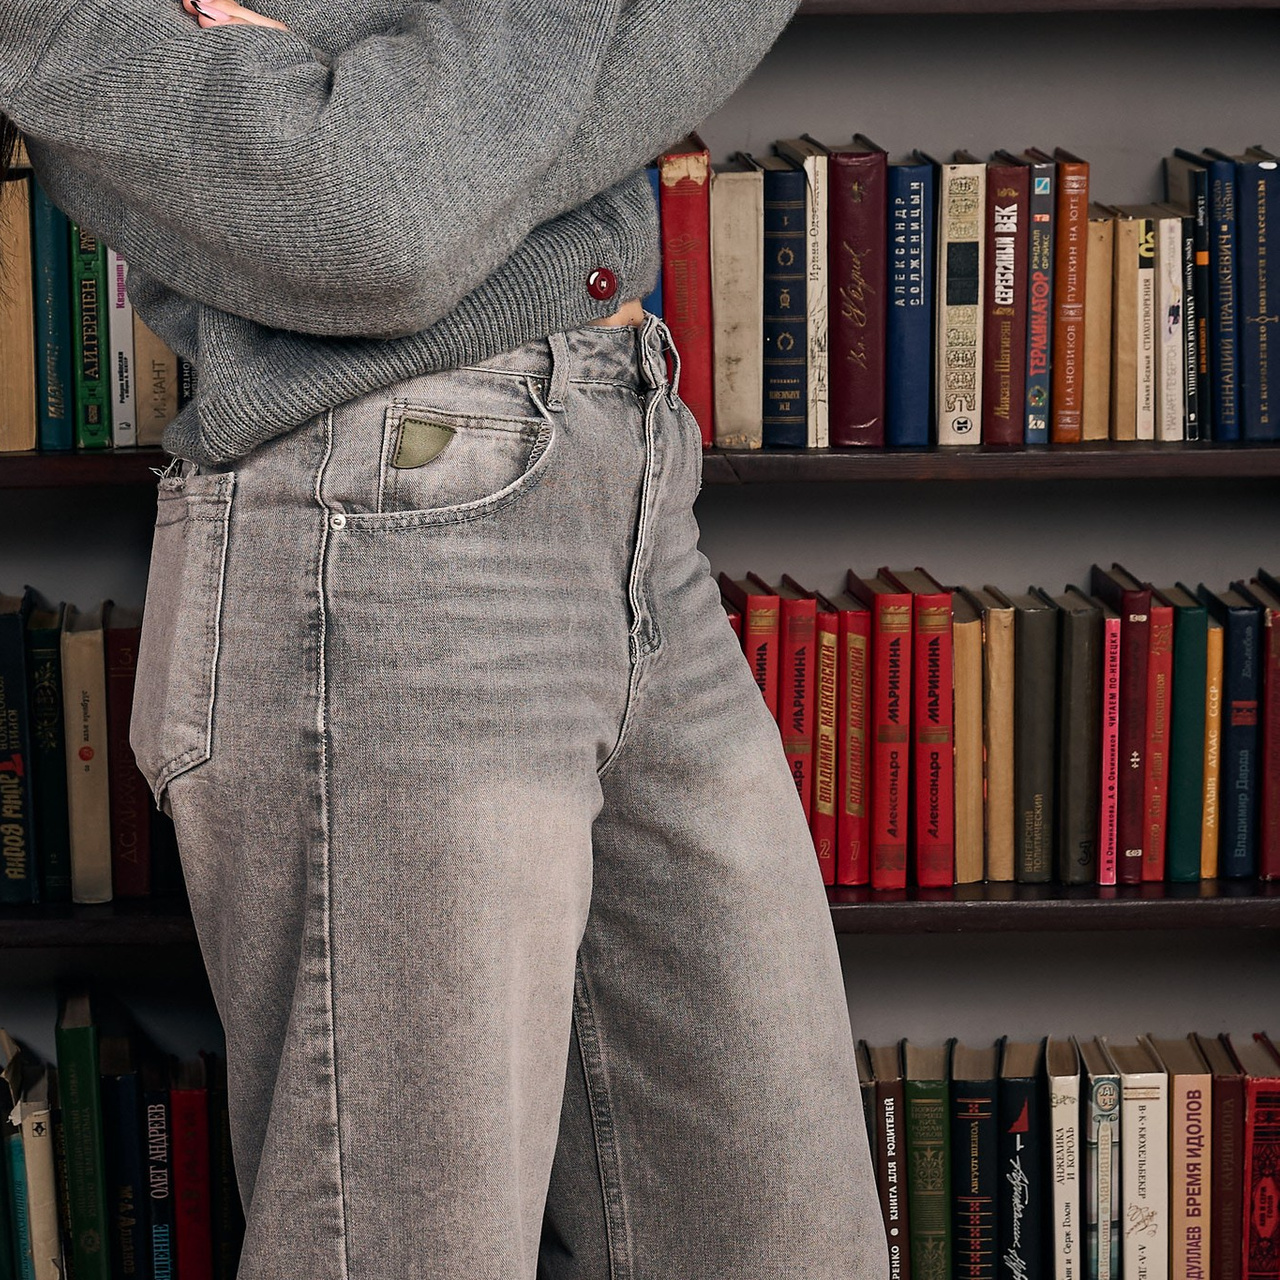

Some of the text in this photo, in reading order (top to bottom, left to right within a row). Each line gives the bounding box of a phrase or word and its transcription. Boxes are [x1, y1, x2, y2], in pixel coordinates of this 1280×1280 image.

[895, 196, 907, 307] АЛЕКСАНДР
[909, 181, 921, 306] СОЛЖЕНИЦЫН
[1032, 229, 1041, 269] РЭНДАЛЛ
[1041, 234, 1050, 269] ФРЭЙКС
[1067, 197, 1079, 302] ПУШКИН НА ЮГЕ
[994, 203, 1018, 419] Микаэл Шатирян СЕРЕБРЯНЫЙ ВЕК
[1028, 270, 1049, 377] ТЕРМИНАТОР
[1142, 278, 1152, 412] Демьян Бедный СТИХОТВОРЕНИЯ
[1220, 234, 1235, 425] ГЕННАДИЙ ПРАШКЕВИЧ
[793, 646, 806, 734] МАРИНИНА
[819, 644, 835, 804] ВЛАДИМИР МАЯКОВСКИЙ
[848, 646, 864, 805] ВЛАДИМИР МАЯКОВСКИЙ
[1108, 632, 1118, 728] ЧИТАЕМ ПО-НЕМЕЦКИ
[886, 637, 901, 838] Александра МАРИНИНА
[927, 635, 941, 839] Александра МАРИНИНА
[1206, 685, 1219, 828] МАЛЫЙ АТЛАС СССР
[1025, 810, 1034, 872] ВЕНГЕРСКИЙ
[1033, 793, 1044, 873] ПОЛИТИЧЕСКИЙ
[1234, 749, 1251, 858] Владимир Дарда
[146, 1103, 169, 1199] ОЛЕГ АНДРЕЕВ
[1055, 1127, 1066, 1185] АНЖЕЛИКА
[1186, 1089, 1204, 1158] ИДОЛОВ
[1186, 1162, 1202, 1217] БРЕМЯ
